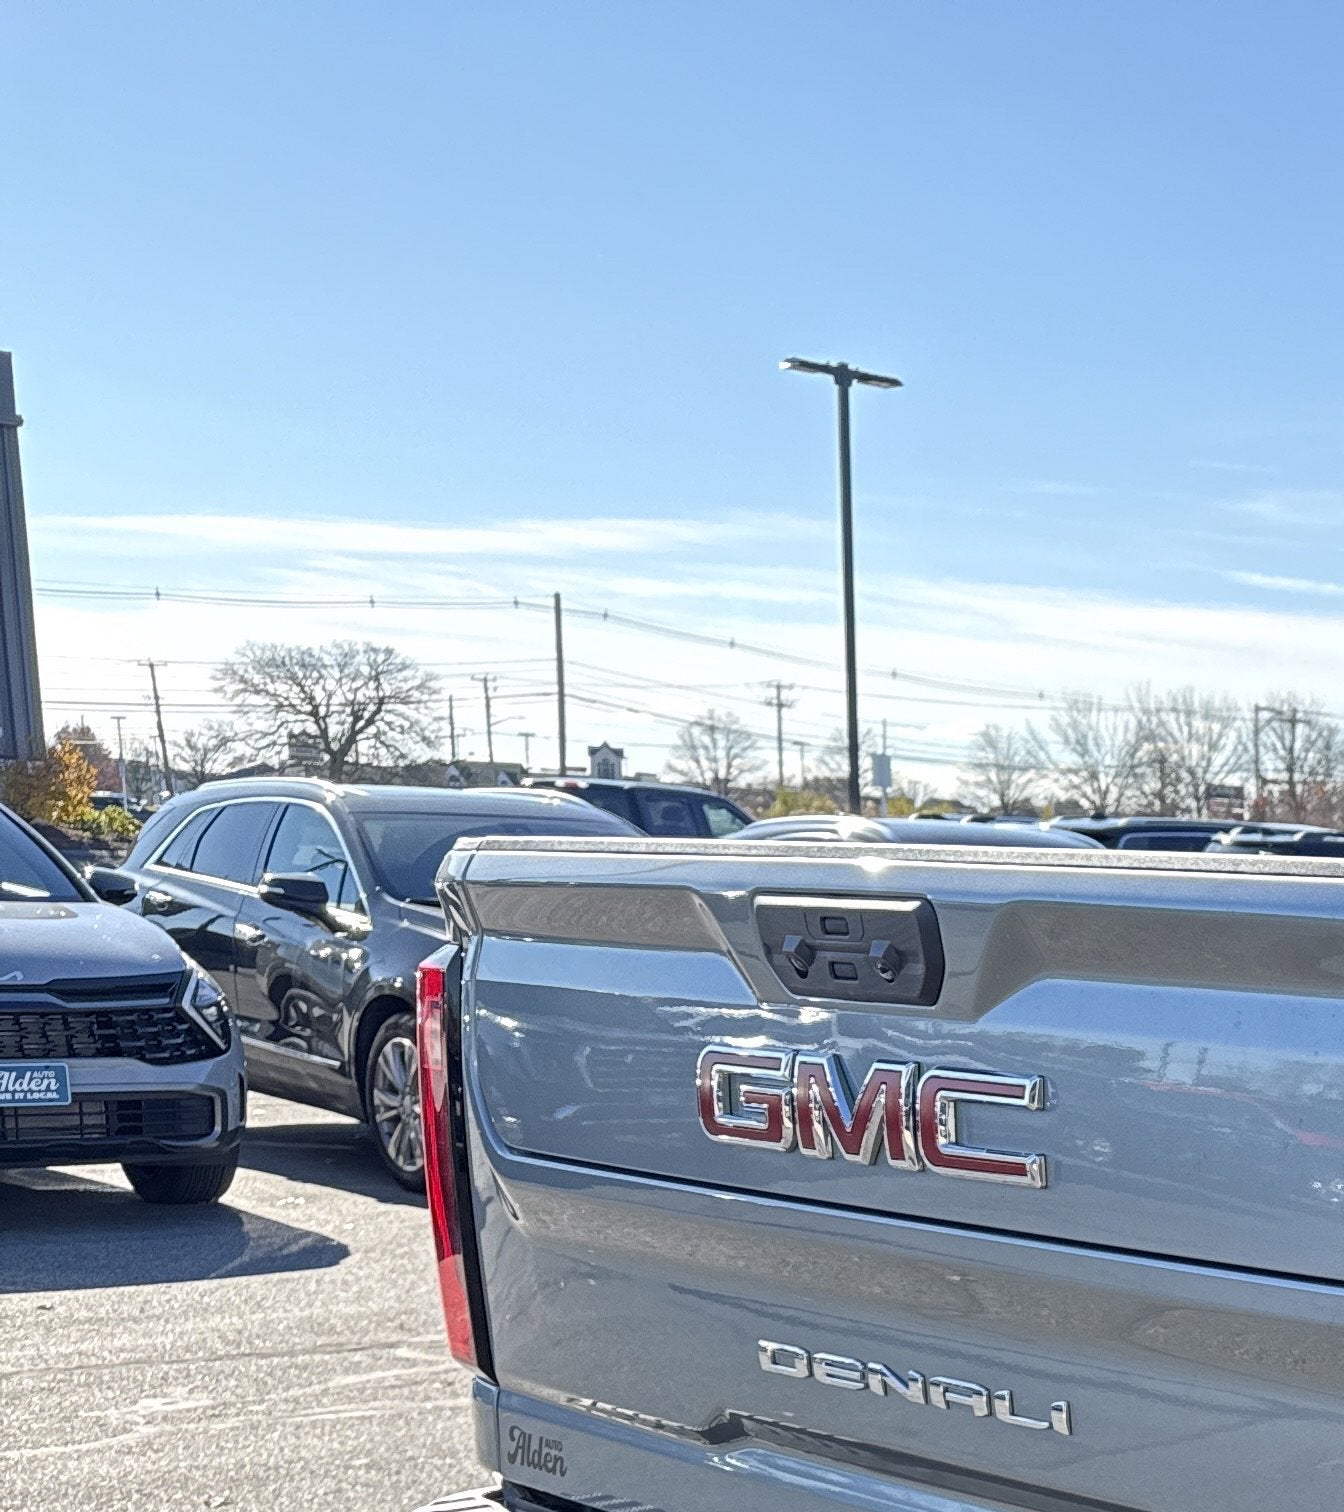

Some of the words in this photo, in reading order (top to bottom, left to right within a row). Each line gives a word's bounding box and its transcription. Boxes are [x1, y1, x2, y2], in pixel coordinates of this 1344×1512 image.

[0, 1070, 60, 1092] Alden
[32, 1070, 55, 1078] AUTO
[14, 1092, 25, 1100] IT
[26, 1091, 60, 1100] LOCAL
[695, 1044, 1048, 1190] GMC
[757, 1338, 1073, 1436] DENALI
[507, 1425, 568, 1478] Alden
[544, 1438, 563, 1453] AUTO
